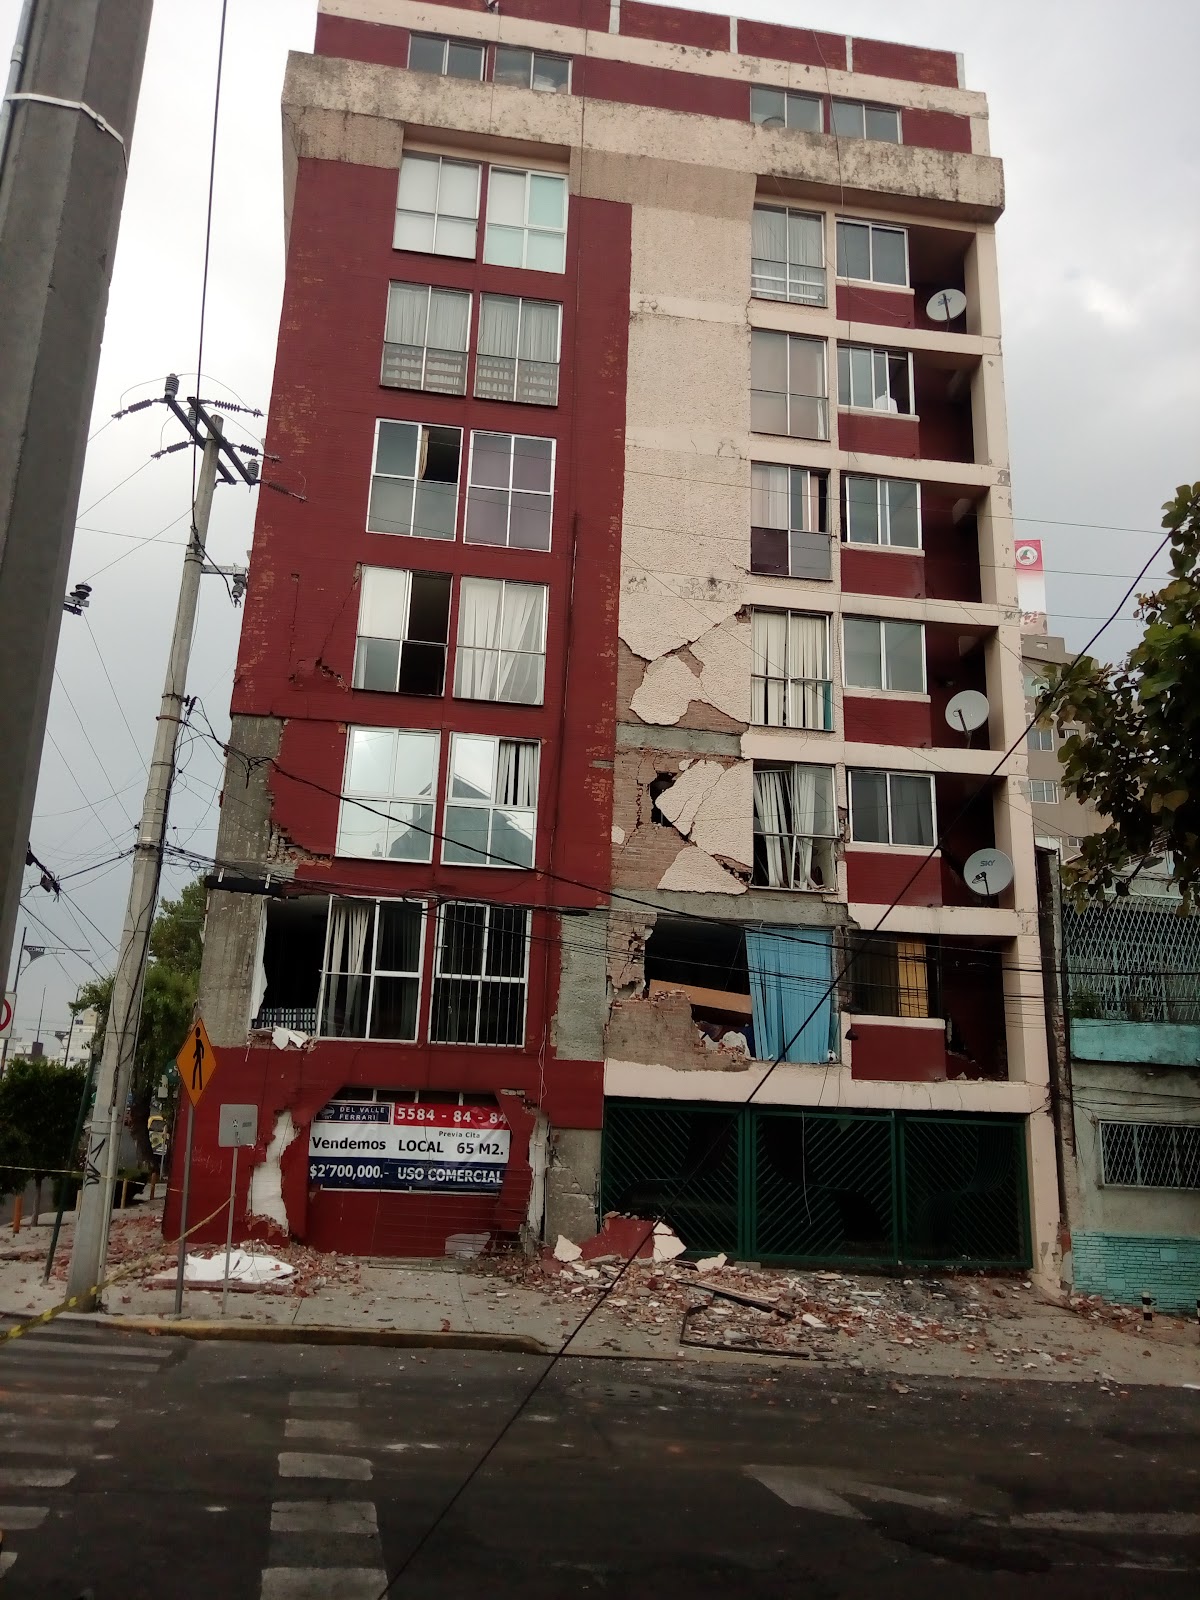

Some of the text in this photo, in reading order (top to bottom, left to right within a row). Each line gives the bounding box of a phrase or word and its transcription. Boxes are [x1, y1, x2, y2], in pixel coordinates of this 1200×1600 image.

[397, 1107, 435, 1121] 5584
[453, 1110, 471, 1123] 84
[438, 1130, 463, 1138] Previa
[312, 1136, 504, 1155] Vendemos LOCAL 65 M2.
[397, 1166, 424, 1180] USO
[427, 1168, 503, 1184] COMERCIAL
